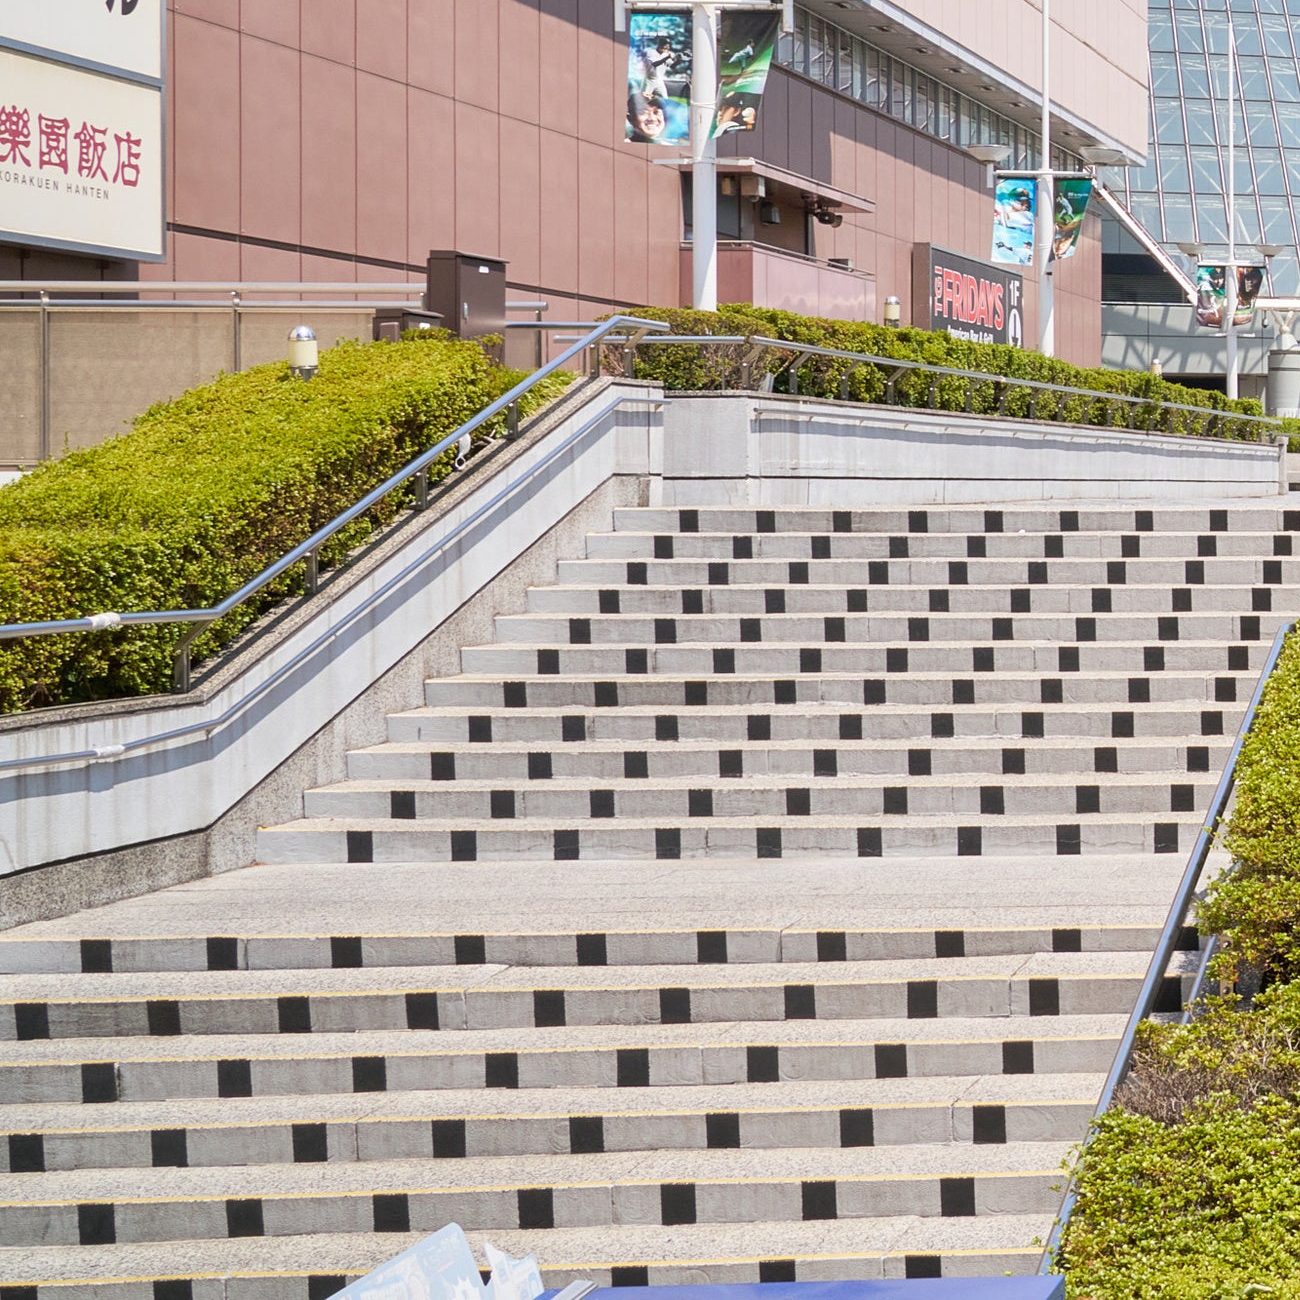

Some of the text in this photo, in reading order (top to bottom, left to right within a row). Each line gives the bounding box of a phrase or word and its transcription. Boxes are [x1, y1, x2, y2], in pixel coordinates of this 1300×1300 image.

[66, 182, 109, 200] HANTEN
[943, 268, 1004, 330] FRIDAYS
[1009, 280, 1020, 307] 1F
